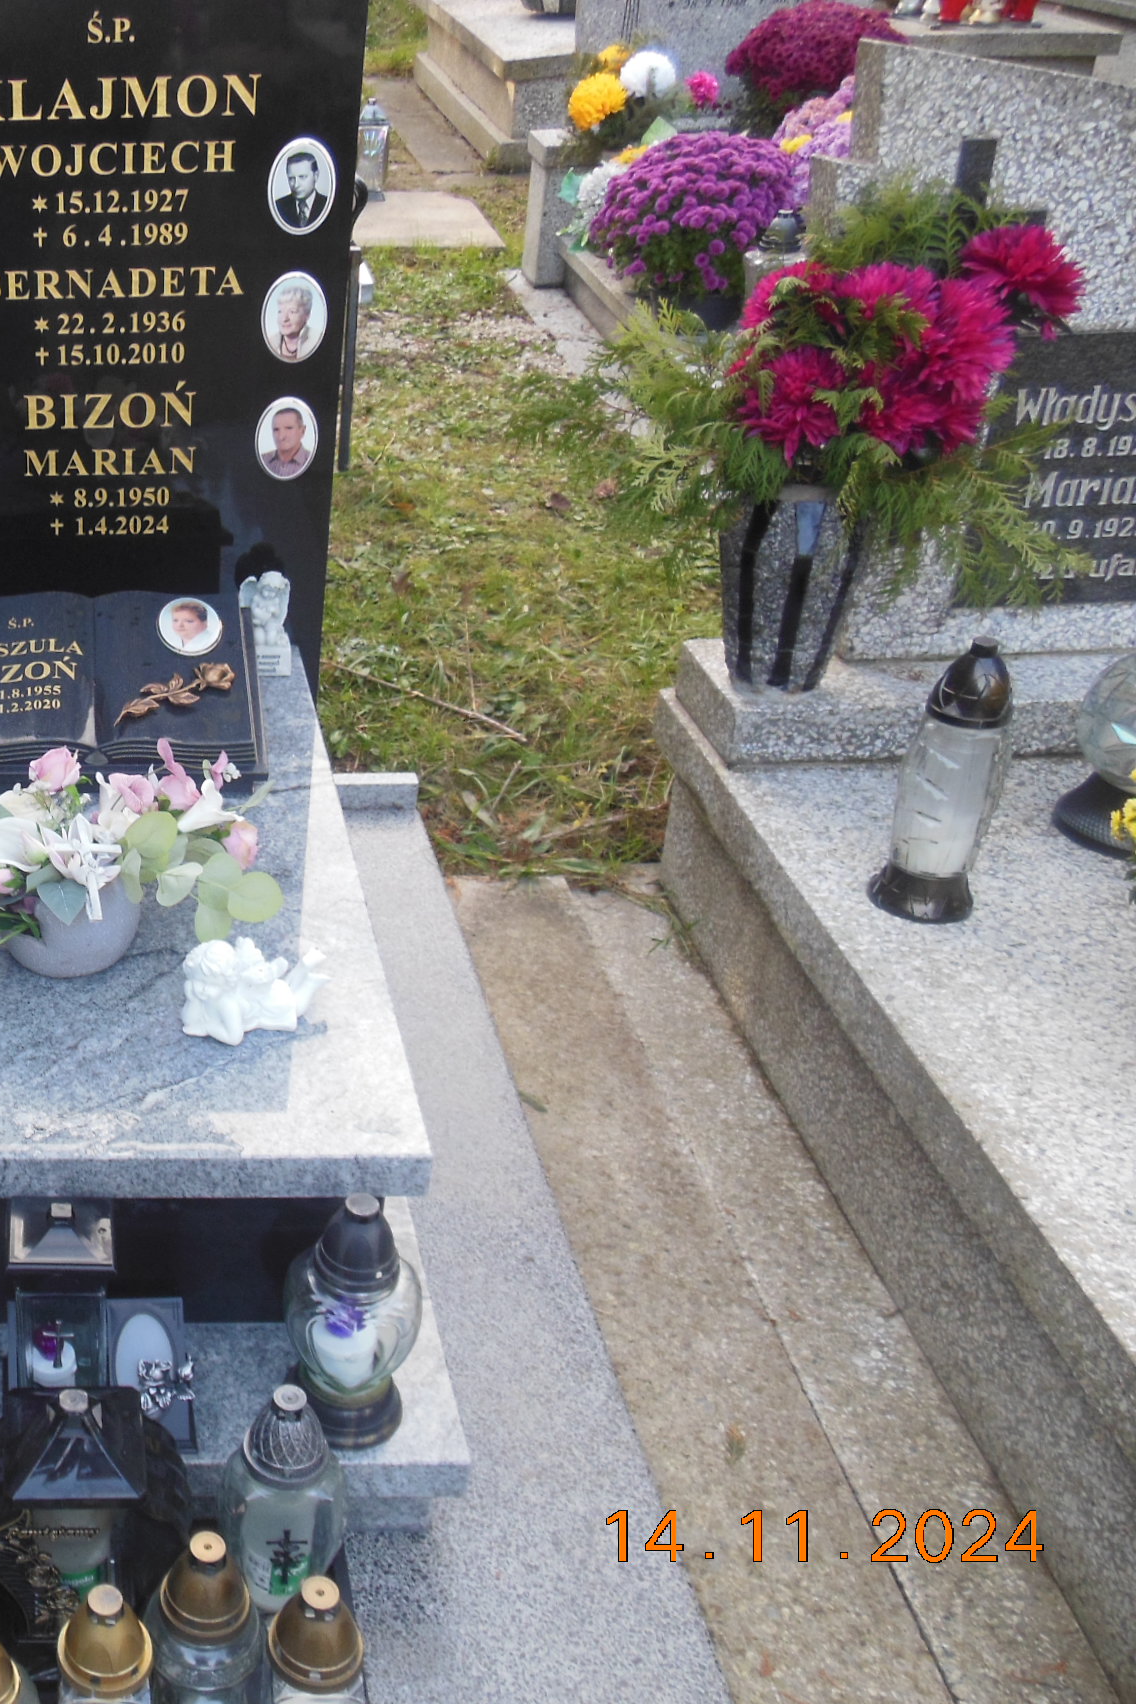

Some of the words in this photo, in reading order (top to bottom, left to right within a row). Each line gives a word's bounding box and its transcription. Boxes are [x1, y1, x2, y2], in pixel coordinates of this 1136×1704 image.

[87, 11, 135, 44] Ś.P.
[55, 189, 189, 214] 15.12.1927
[57, 342, 185, 366] 15.10.2010
[23, 381, 197, 431] BIZOŃ
[23, 446, 196, 477] MARIAN
[73, 486, 171, 508] 8.9.1950
[1022, 468, 1136, 509] Maria
[75, 516, 170, 536] 1.4.2024
